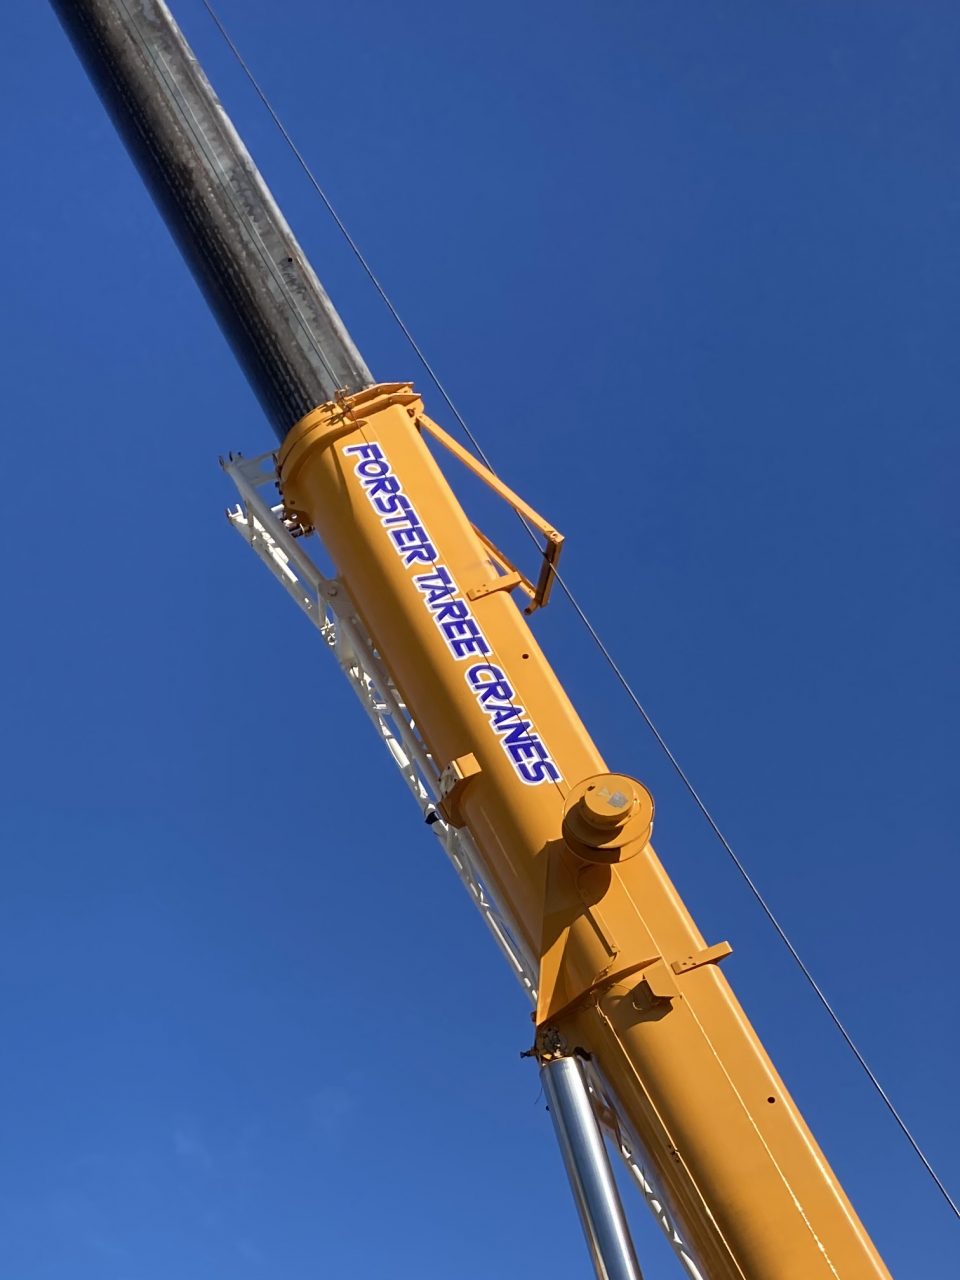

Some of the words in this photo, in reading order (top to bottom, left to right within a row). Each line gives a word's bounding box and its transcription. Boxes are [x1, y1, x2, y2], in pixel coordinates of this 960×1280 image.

[343, 441, 438, 568] FORSTER
[411, 563, 494, 662] TAREE
[464, 663, 563, 785] CRANES
